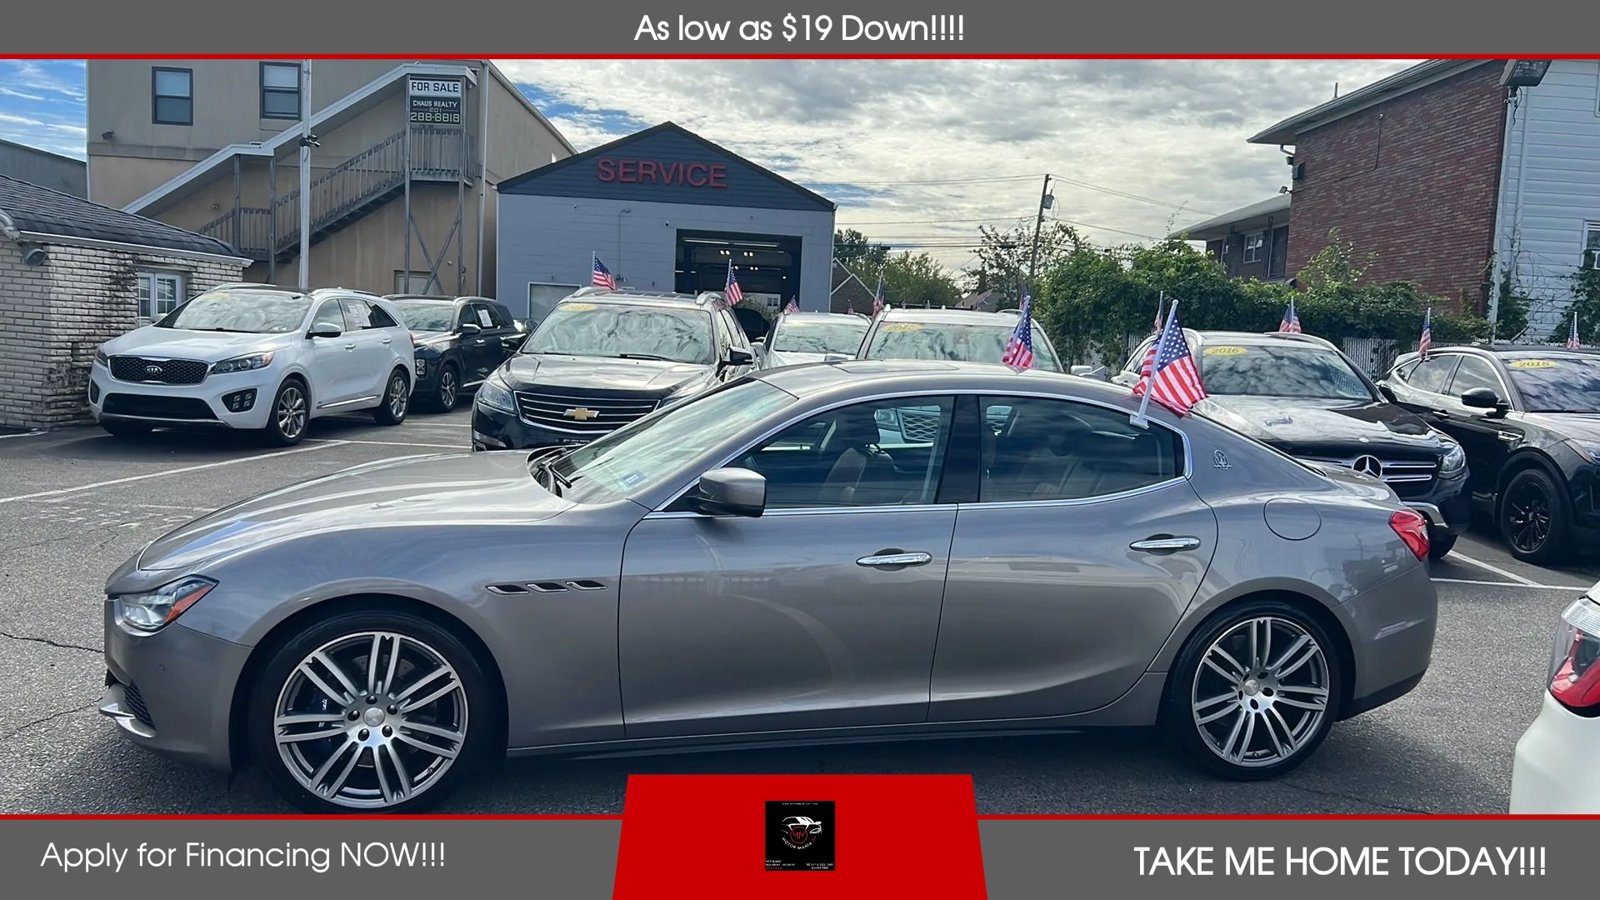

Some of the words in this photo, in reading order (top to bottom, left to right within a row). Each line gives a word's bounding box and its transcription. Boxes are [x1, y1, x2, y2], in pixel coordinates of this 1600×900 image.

[411, 81, 430, 91] FOR
[433, 82, 459, 93] SALE
[597, 159, 727, 187] SERVICE
